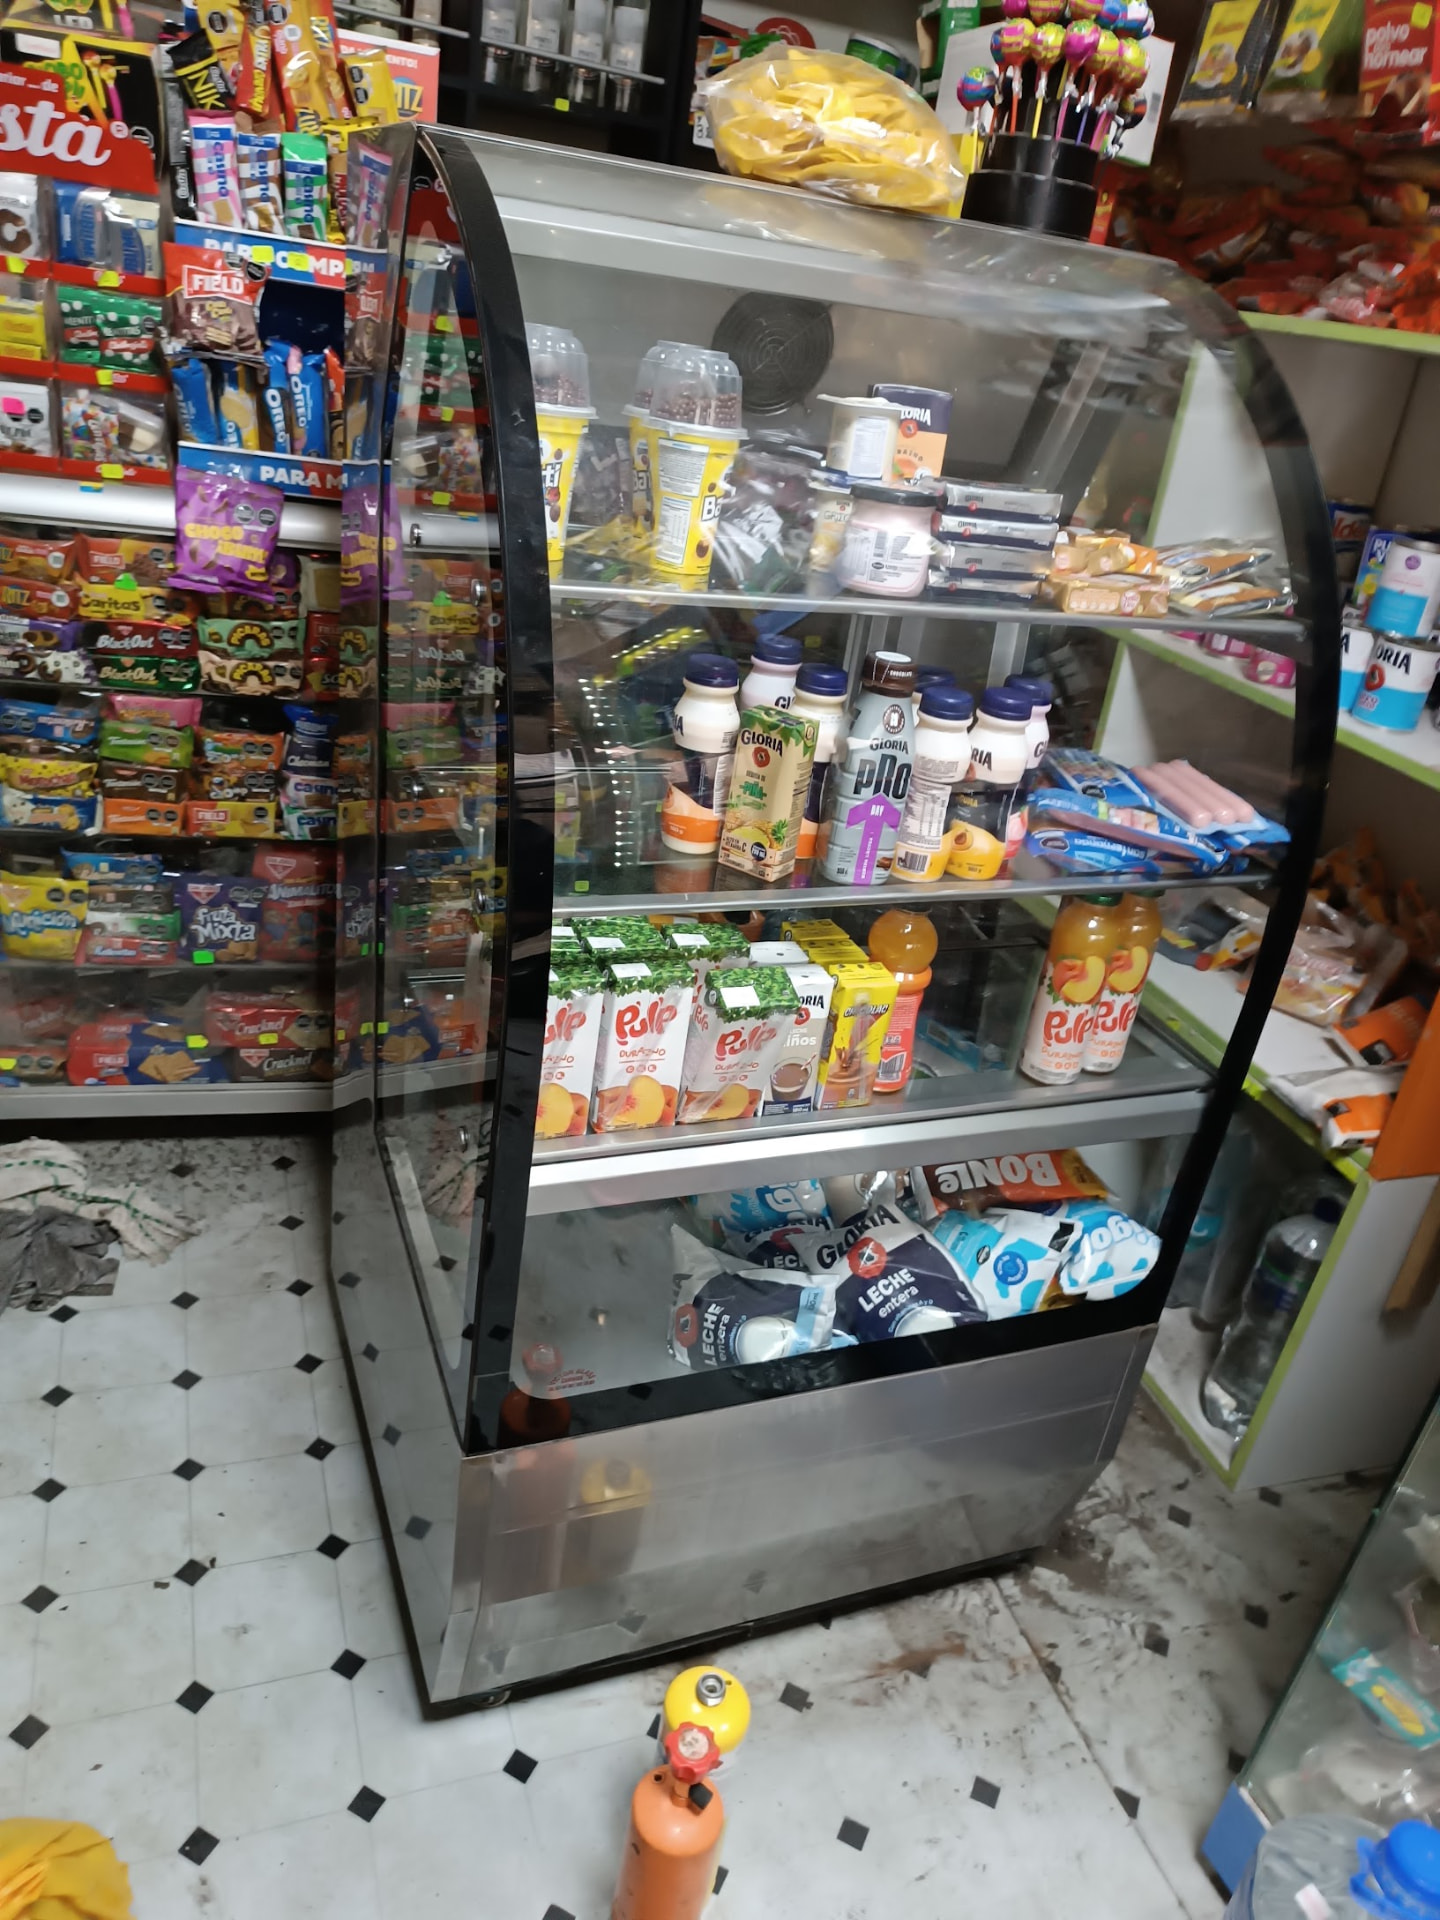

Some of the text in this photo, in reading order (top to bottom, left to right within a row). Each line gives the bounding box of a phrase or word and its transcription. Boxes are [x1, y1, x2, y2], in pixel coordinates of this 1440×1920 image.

[395, 83, 424, 113] ITZ
[0, 100, 112, 166] sta
[192, 273, 245, 295] FIELD
[265, 387, 286, 443] OREO
[290, 375, 307, 428] OREO
[901, 407, 931, 427] LORIA
[260, 465, 321, 489] PARA
[740, 728, 783, 758] GLORIA
[869, 737, 909, 755] GLORIA
[970, 745, 993, 771] RIA
[543, 1003, 587, 1045] ulp
[615, 996, 678, 1046] Pulp
[786, 1033, 817, 1047] iños
[1043, 1008, 1092, 1047] Pulp
[715, 1022, 777, 1062] Pulp
[858, 1267, 916, 1312] LECHE
[878, 1286, 919, 1318] entera
[702, 1302, 725, 1367] LECHE
[716, 1314, 731, 1362] entera
